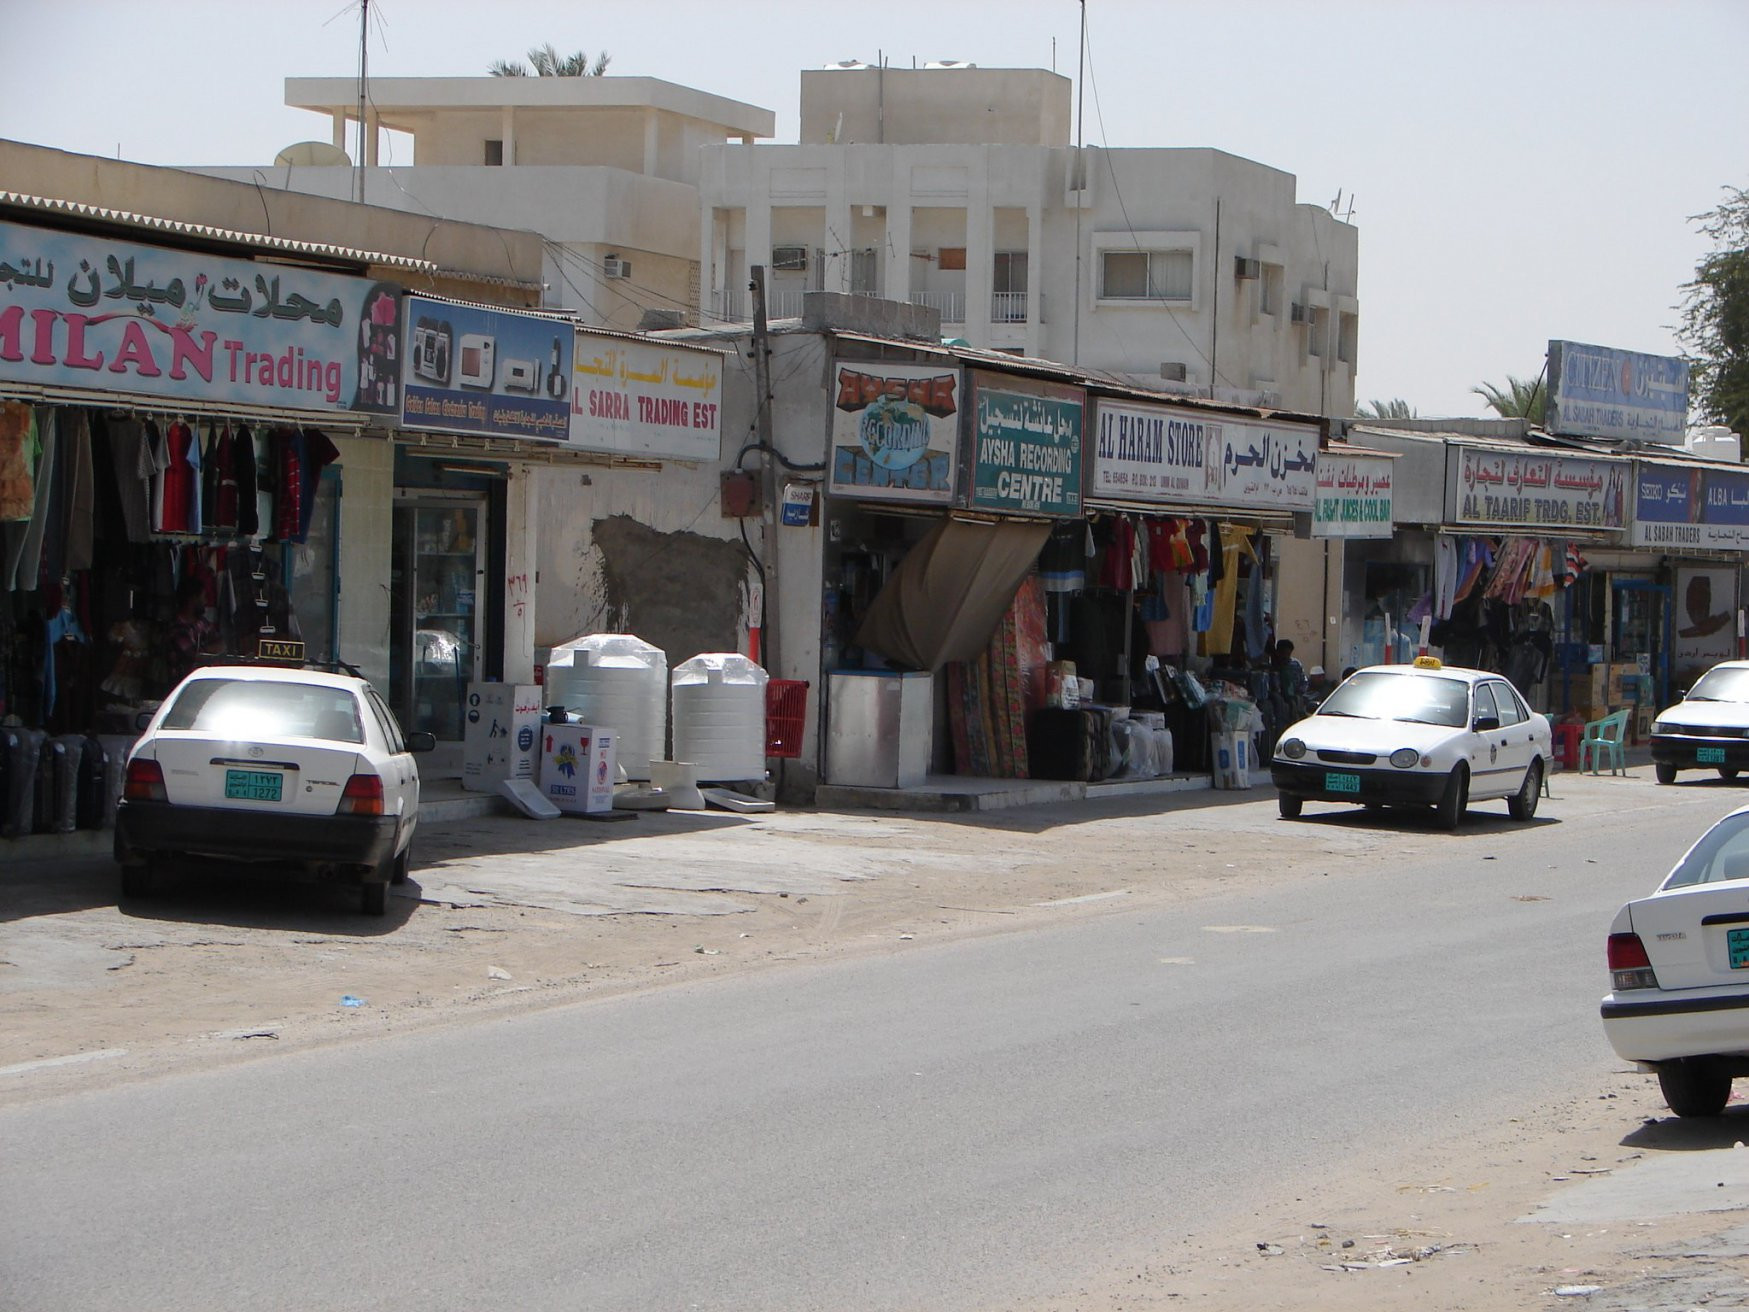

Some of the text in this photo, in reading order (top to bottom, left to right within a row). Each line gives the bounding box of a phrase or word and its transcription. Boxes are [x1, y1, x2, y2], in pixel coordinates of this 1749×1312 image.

[67, 253, 188, 316] ميلان
[208, 273, 344, 329] محلات
[224, 340, 342, 403] Trading
[1566, 351, 1619, 393] CITIZEN
[589, 389, 630, 421] SARRA
[638, 395, 689, 427] TRADING
[693, 402, 717, 430] EST
[980, 438, 1016, 468] AYSHA
[1020, 442, 1072, 474] RECORDING
[1098, 412, 1204, 468] AL HARAM STORE
[1223, 432, 1270, 488] الحرم
[1269, 438, 1316, 482] مخزن
[790, 490, 811, 501] SHARP
[997, 470, 1063, 503] CENTRE
[1641, 483, 1662, 500] SEIKO
[1707, 487, 1728, 506] ALBA
[1462, 494, 1601, 525] AL TAARIF TRDG. EST.
[1644, 525, 1652, 542] AL
[1675, 526, 1700, 544] TRADERS
[265, 643, 297, 657] TAXI
[254, 788, 277, 800] 1272
